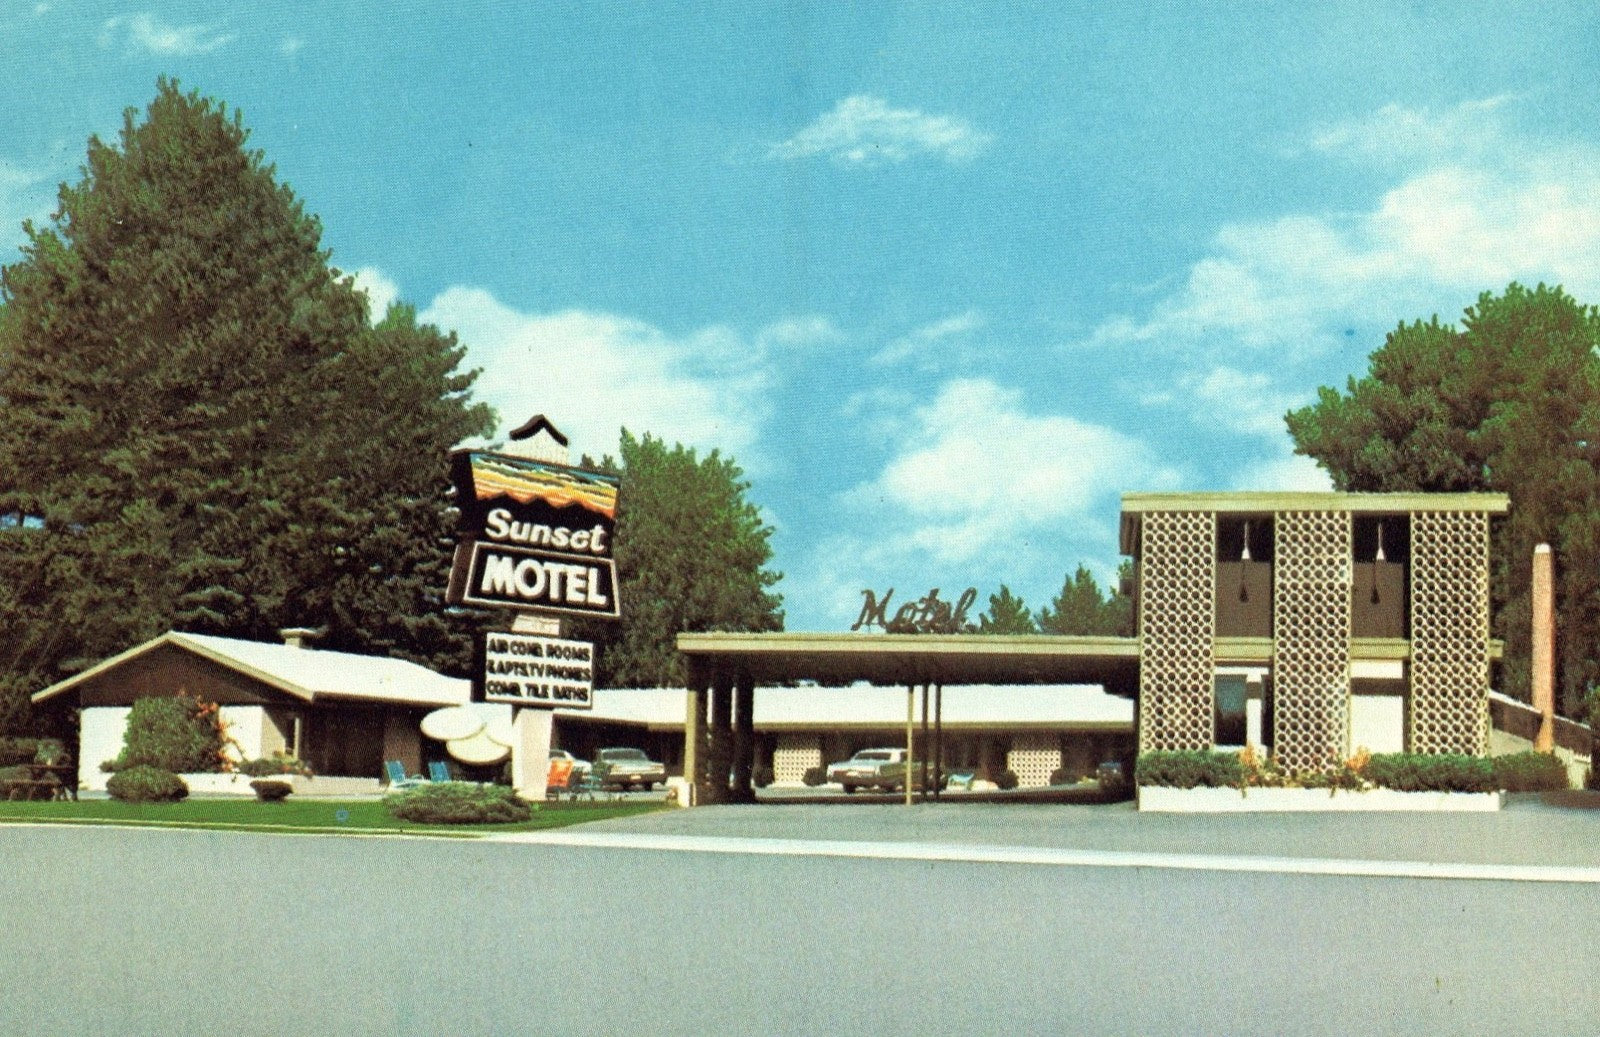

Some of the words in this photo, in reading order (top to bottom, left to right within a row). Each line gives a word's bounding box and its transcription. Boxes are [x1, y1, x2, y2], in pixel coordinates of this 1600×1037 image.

[485, 508, 606, 552] Sunset
[481, 554, 607, 606] MOTEL
[851, 587, 978, 633] Motel
[488, 638, 508, 654] AIR
[545, 643, 590, 662] ROOMS
[528, 662, 544, 678] TV
[545, 663, 592, 682] PHONES
[525, 682, 549, 699] TILE
[552, 684, 589, 702] BATHS
